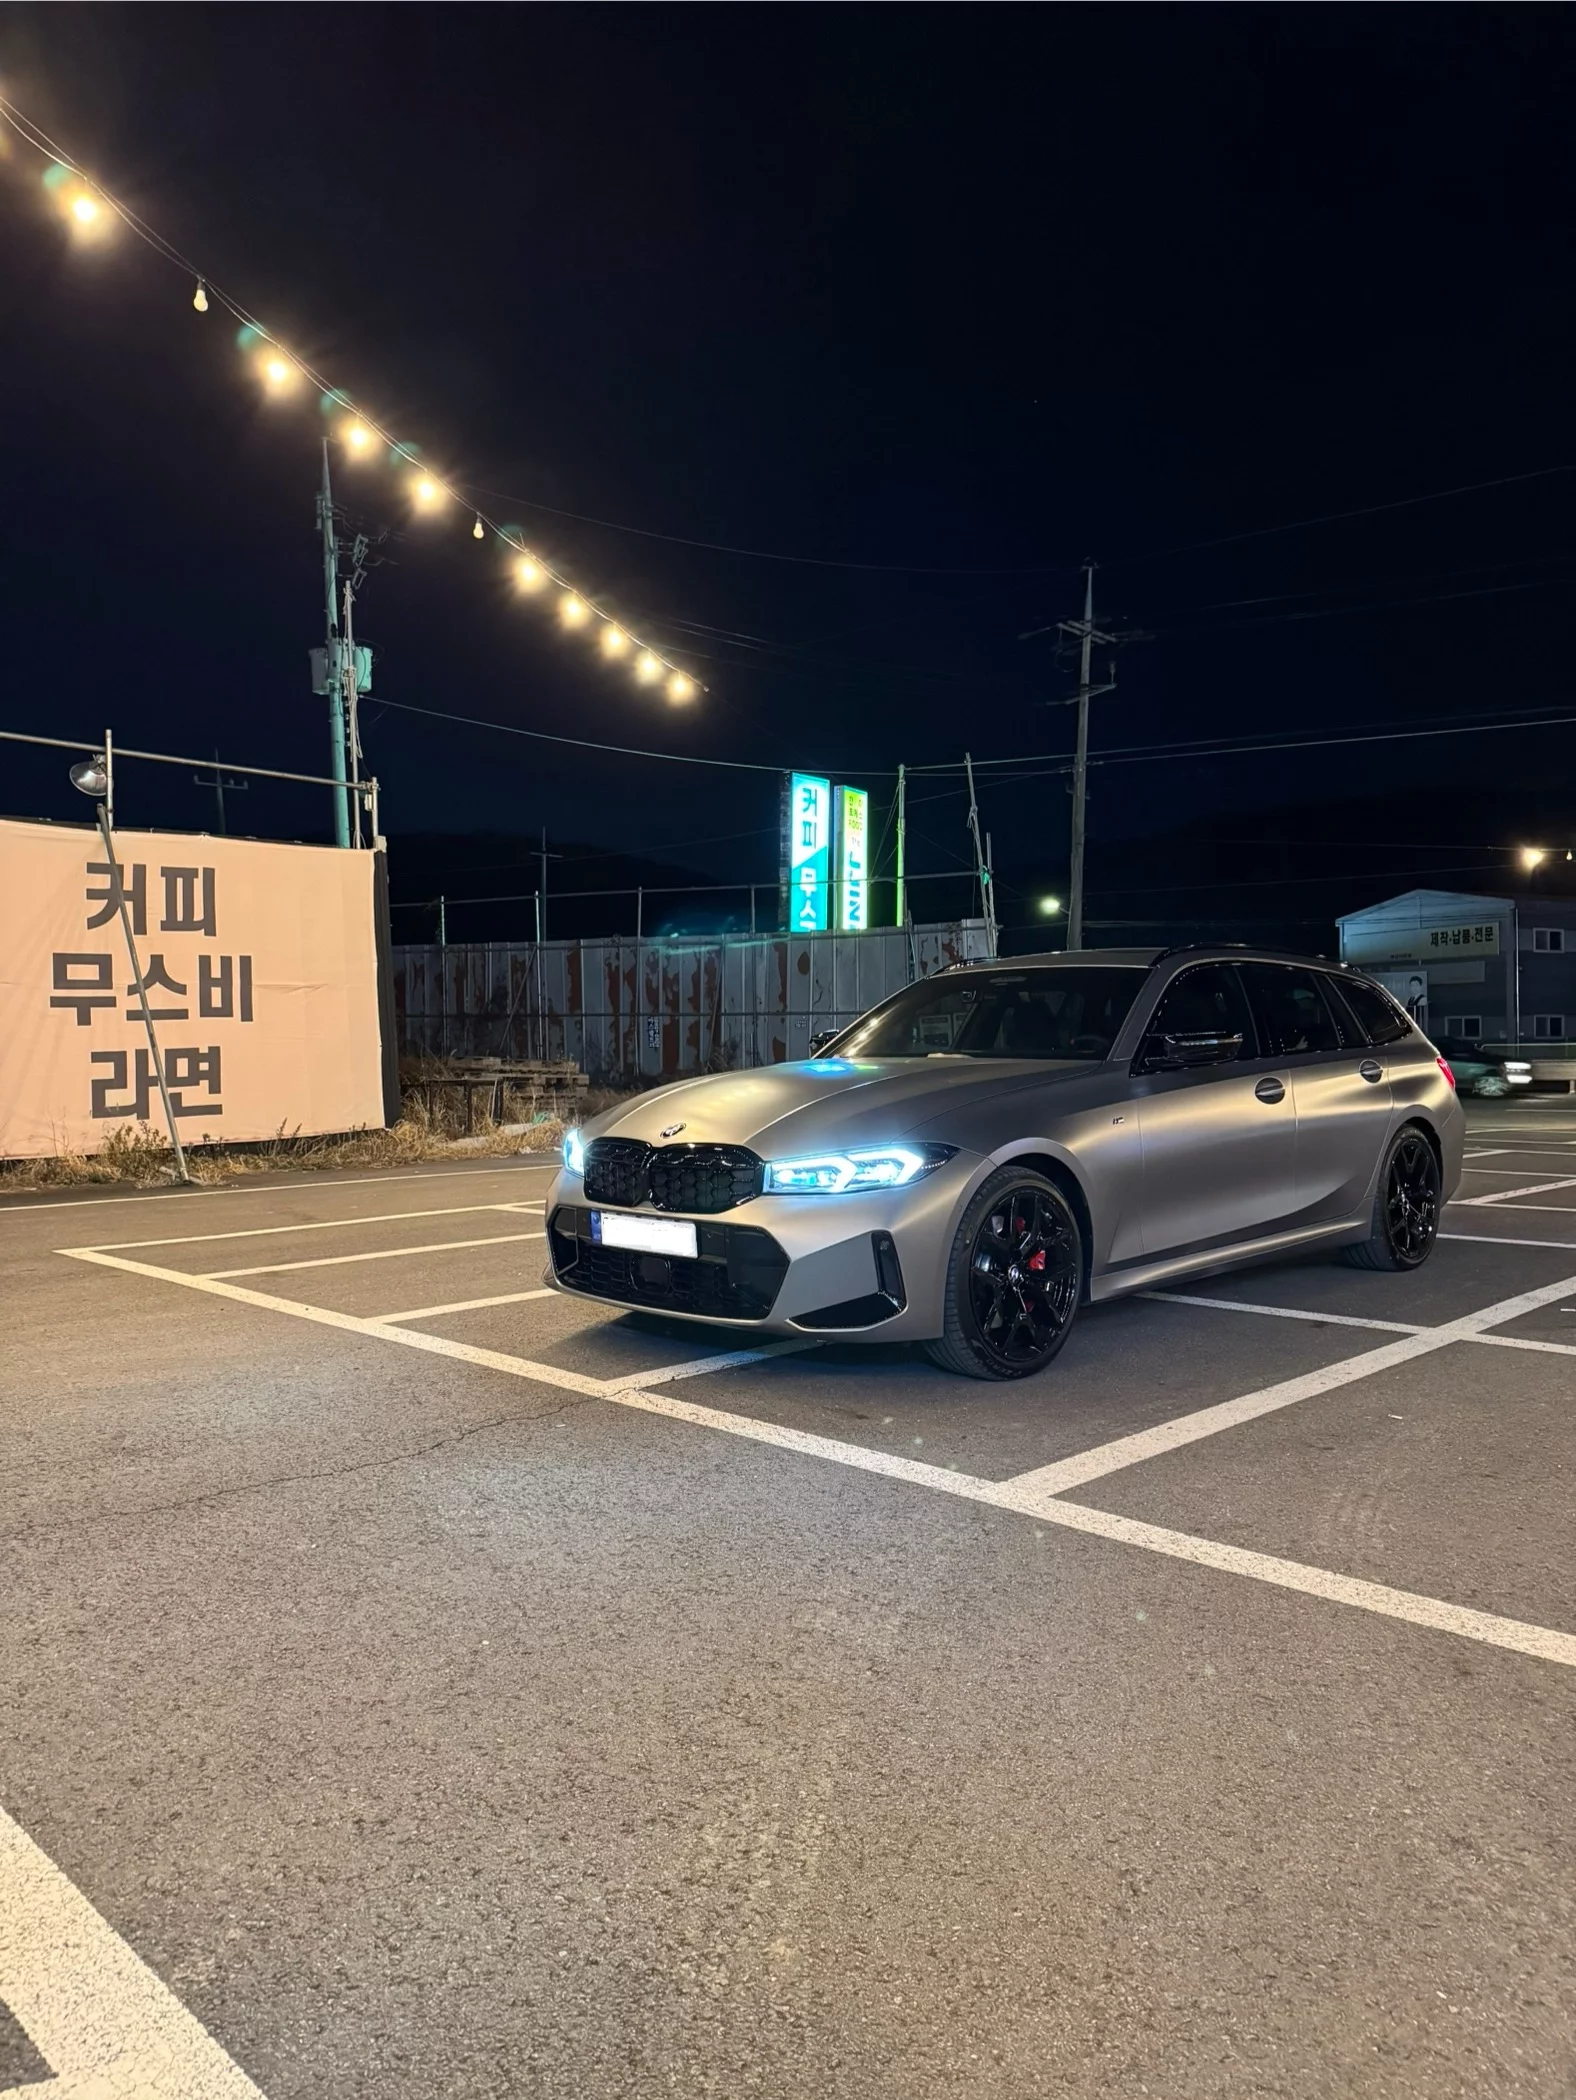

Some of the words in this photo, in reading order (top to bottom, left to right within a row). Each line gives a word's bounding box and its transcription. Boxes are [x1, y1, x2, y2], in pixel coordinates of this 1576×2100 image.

[801, 787, 817, 849] 커피
[86, 862, 217, 937] 커피
[50, 953, 254, 1026] 무스비
[91, 1046, 224, 1120] 라면
